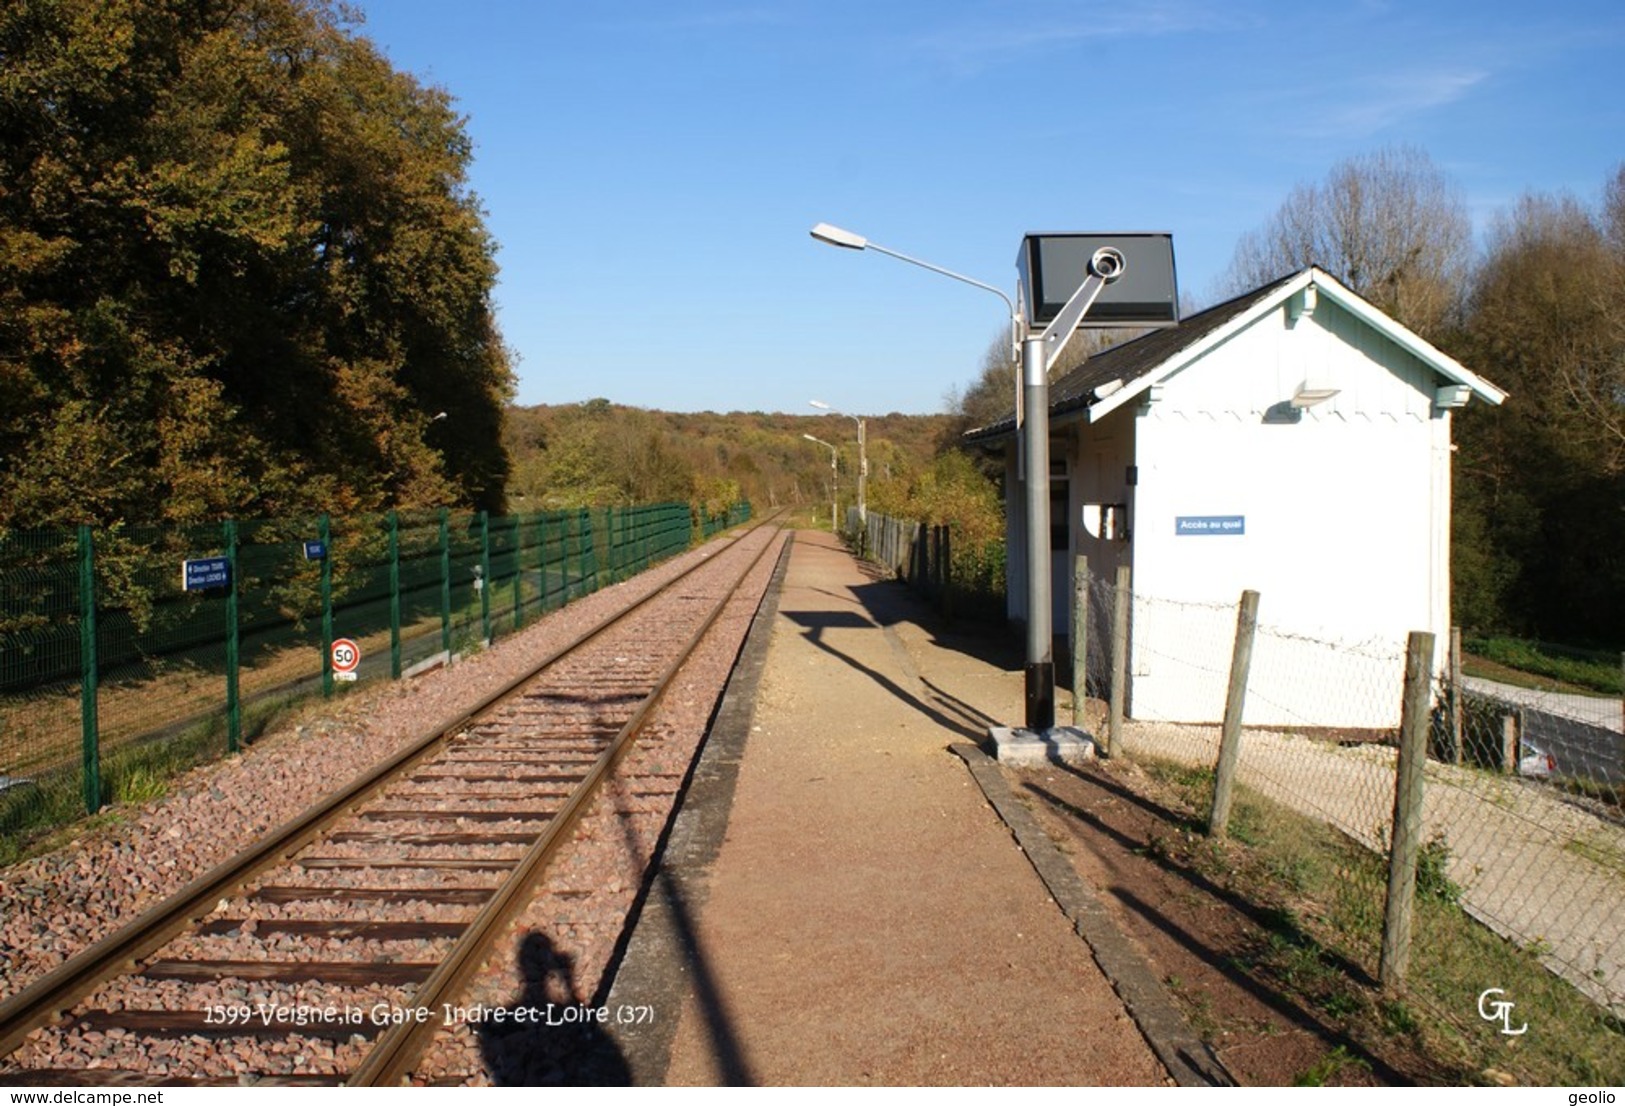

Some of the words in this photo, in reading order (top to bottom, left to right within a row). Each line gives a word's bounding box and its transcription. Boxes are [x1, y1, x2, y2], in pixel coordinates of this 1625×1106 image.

[1181, 520, 1208, 529] Accès
[1209, 521, 1221, 529] au
[1222, 519, 1242, 530] quai
[335, 649, 353, 663] 50
